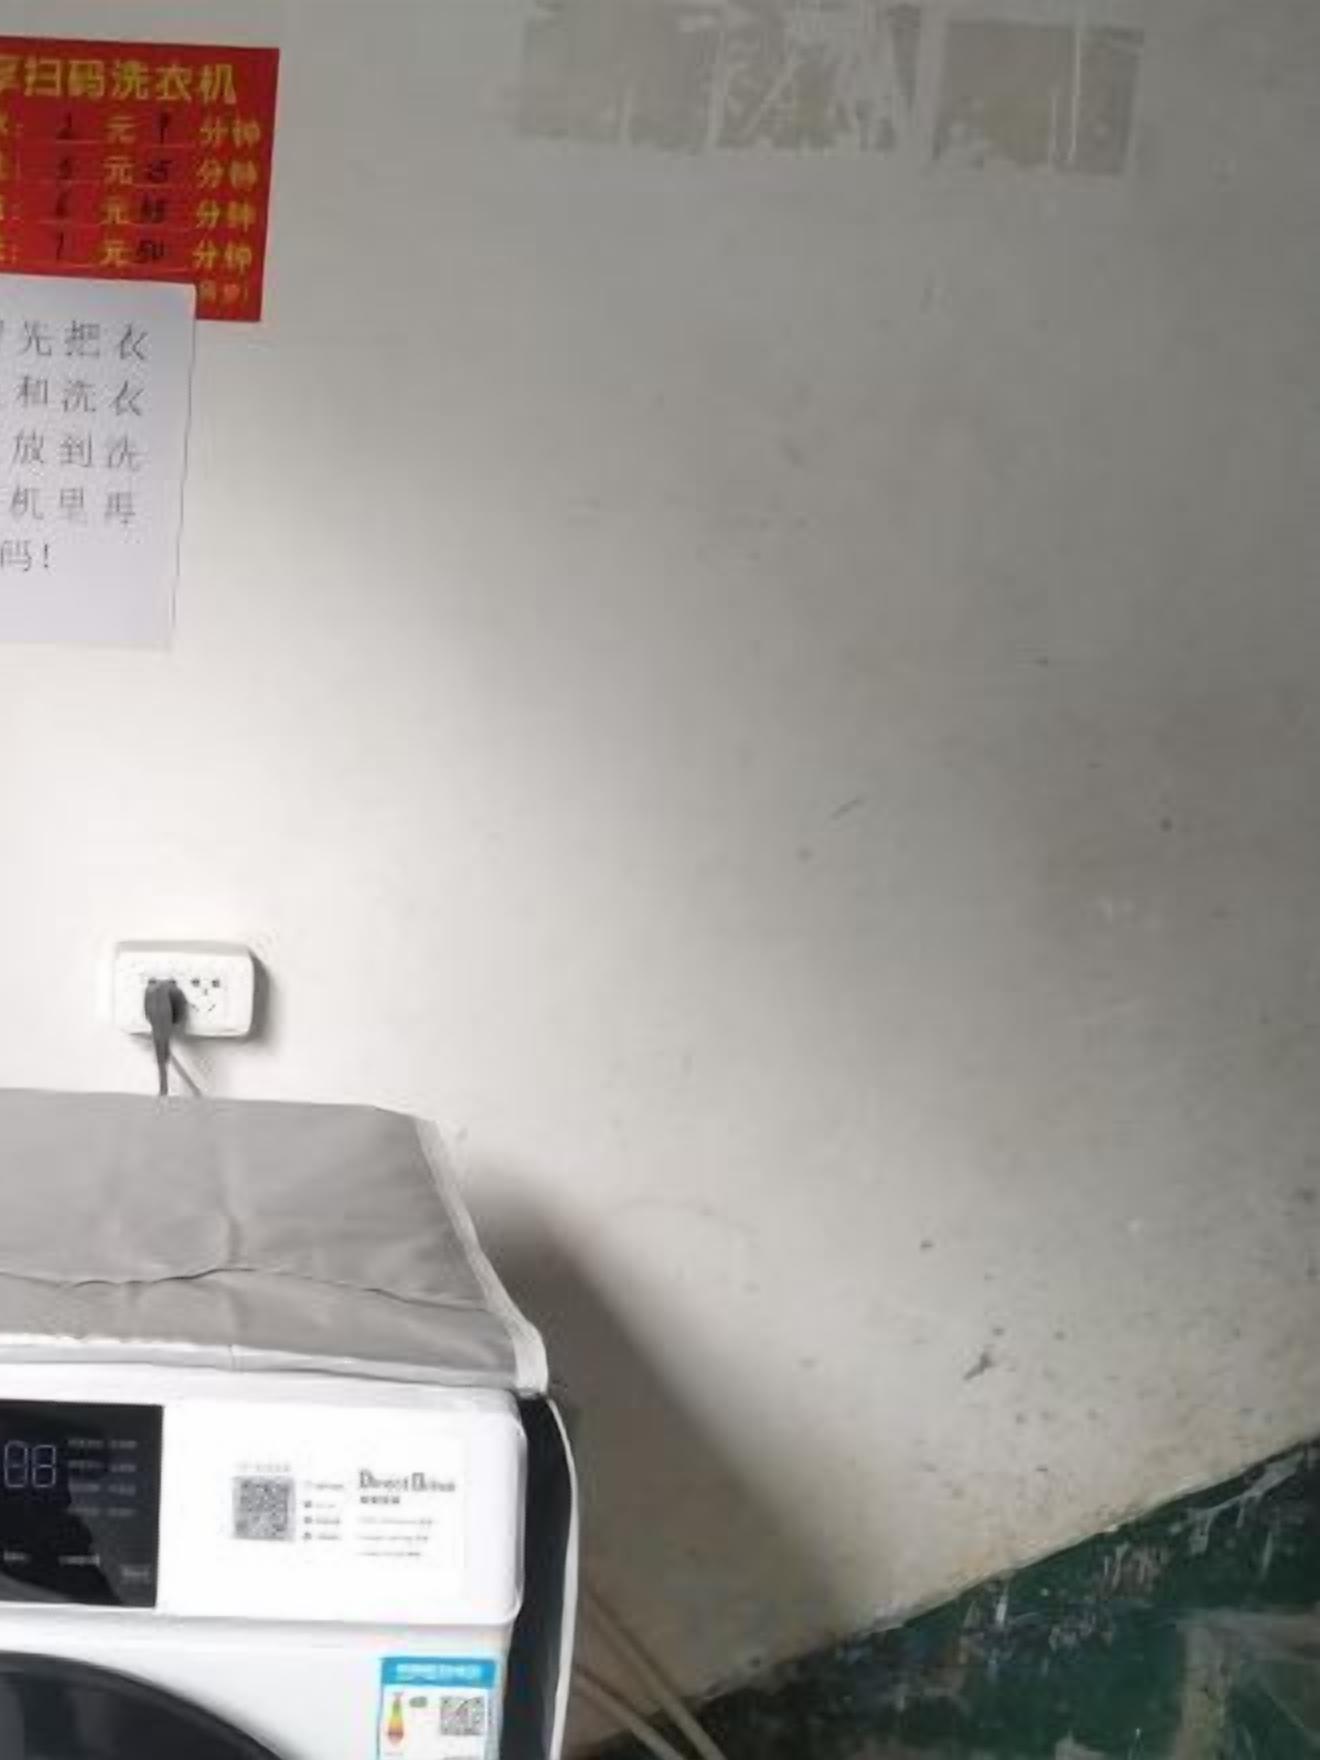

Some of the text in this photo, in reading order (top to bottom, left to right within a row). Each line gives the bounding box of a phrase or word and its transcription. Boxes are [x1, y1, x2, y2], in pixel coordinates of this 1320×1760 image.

[103, 155, 135, 185] 元
[102, 197, 132, 225] 元
[98, 238, 131, 268] 元
